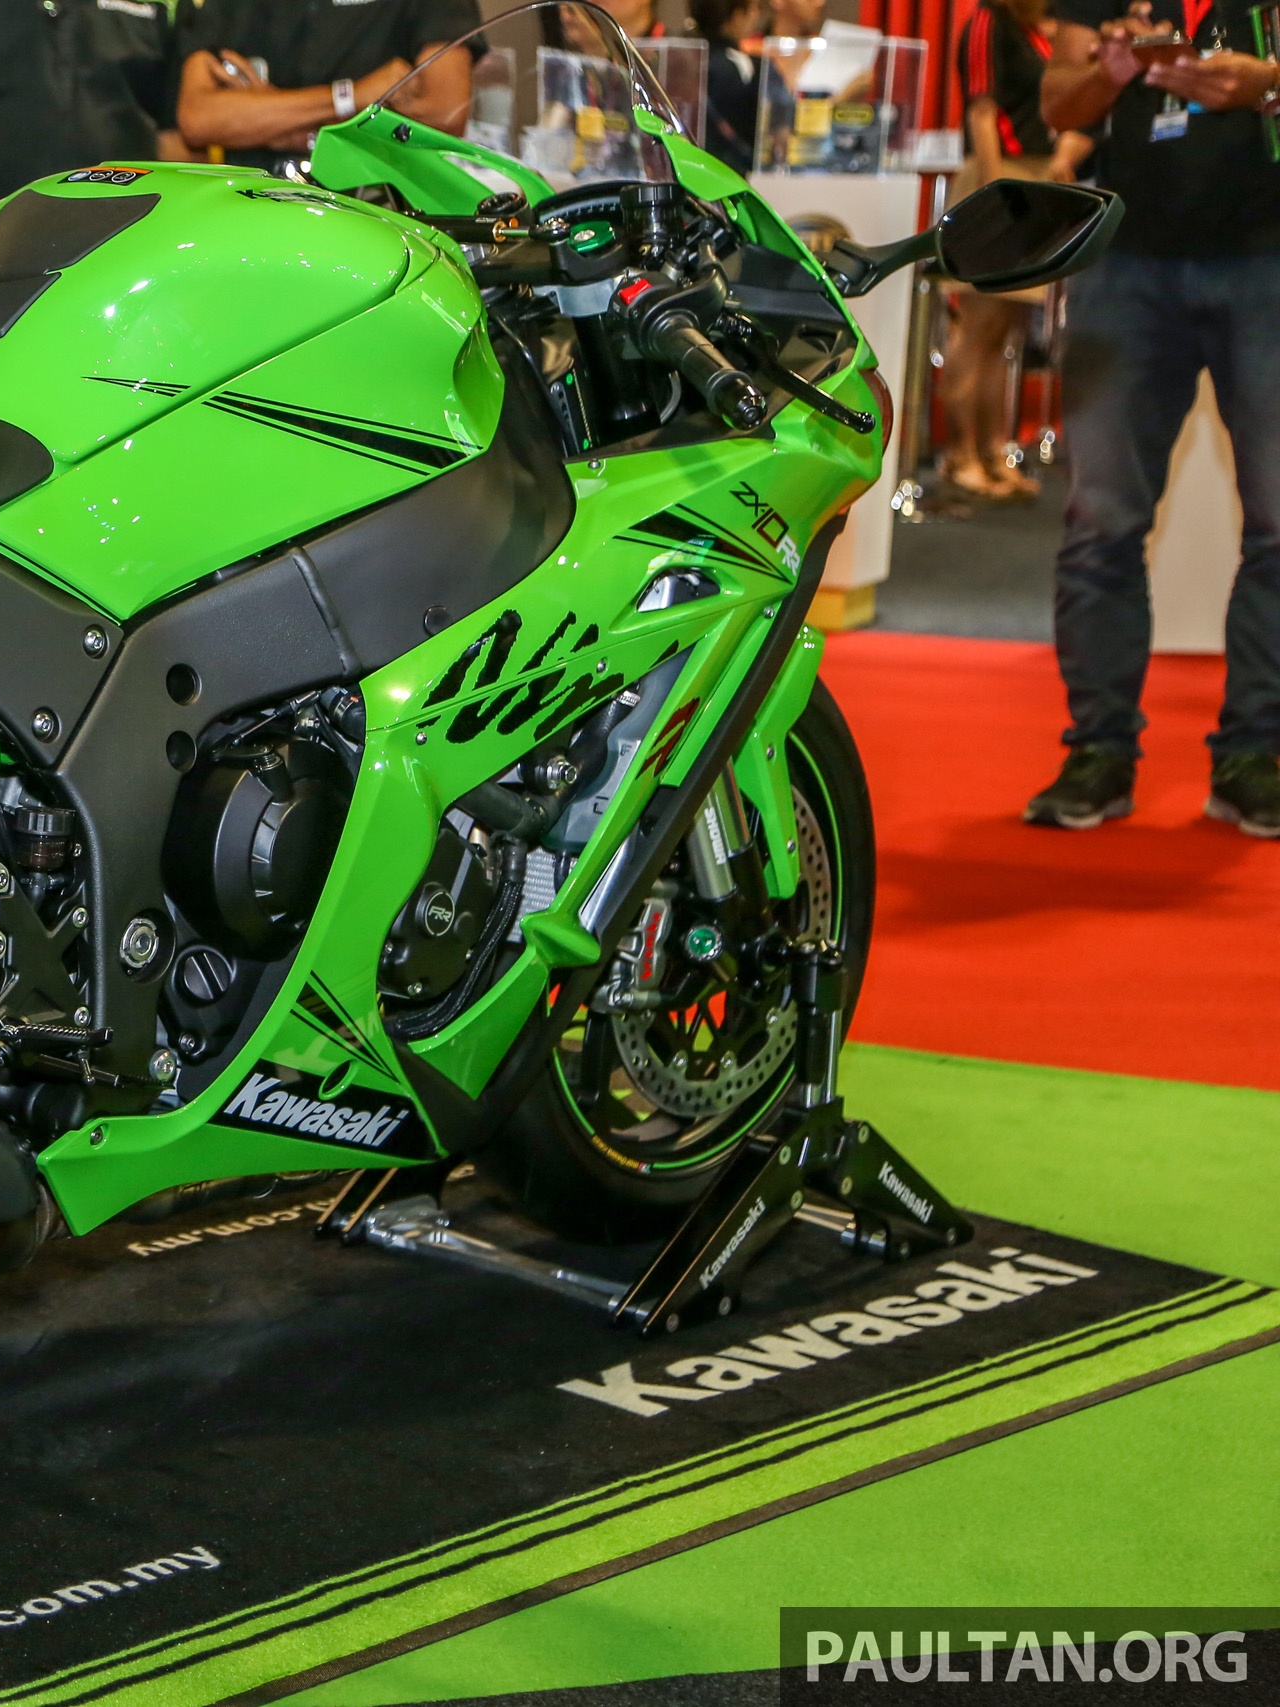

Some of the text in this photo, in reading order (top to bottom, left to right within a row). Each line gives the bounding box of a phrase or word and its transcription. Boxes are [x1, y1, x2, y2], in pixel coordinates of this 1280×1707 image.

[223, 1072, 410, 1147] Kawasaki
[877, 1161, 934, 1224] Kawasaki
[699, 1197, 766, 1290] Kawasaki
[556, 1247, 1099, 1417] Kawasaki
